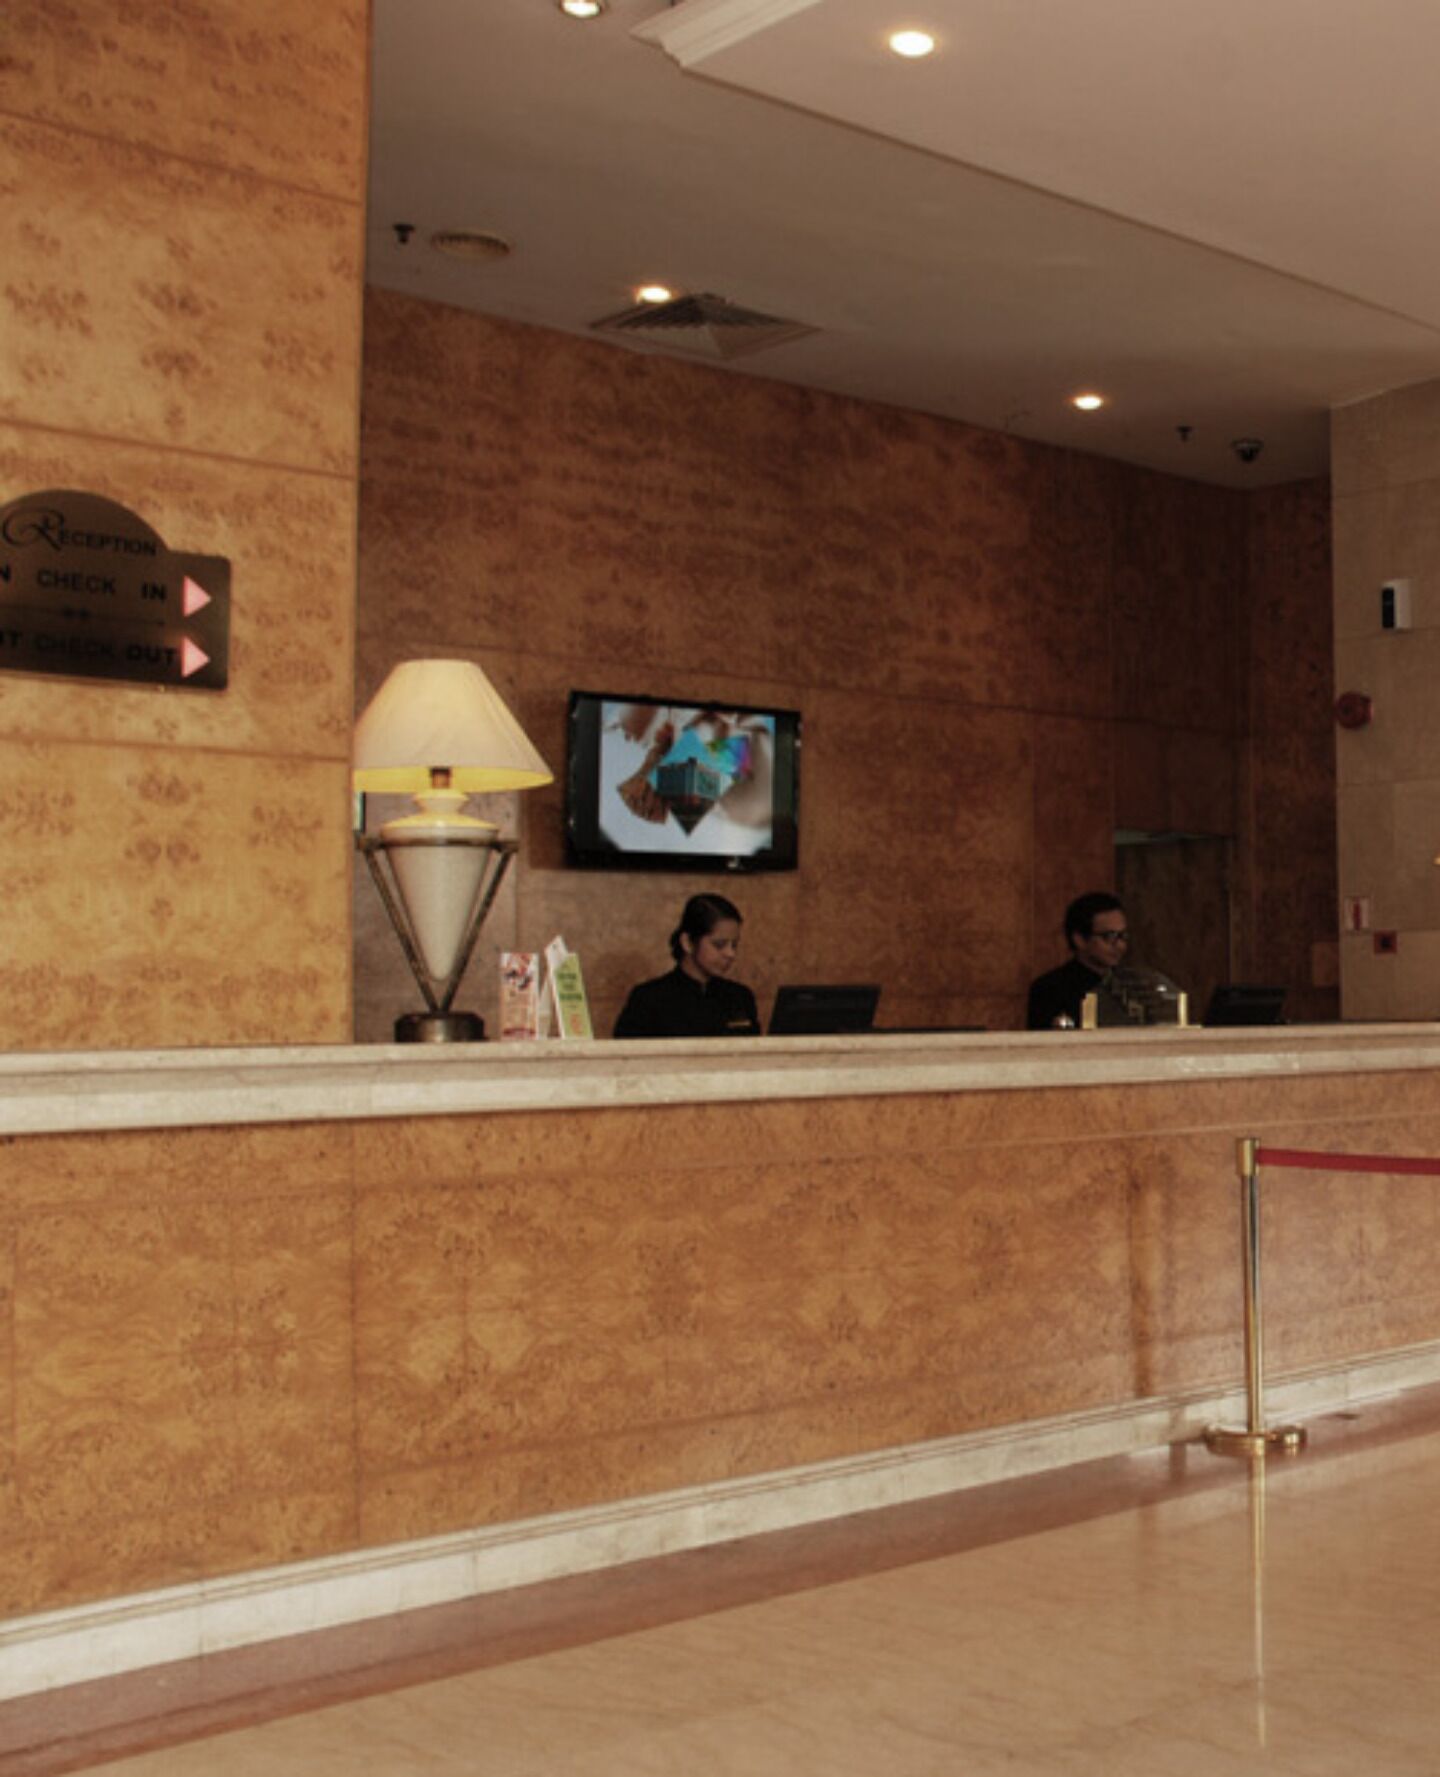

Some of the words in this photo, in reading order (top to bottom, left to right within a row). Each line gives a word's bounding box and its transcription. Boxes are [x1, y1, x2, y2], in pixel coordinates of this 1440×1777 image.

[37, 569, 116, 596] CHECK
[141, 582, 166, 603] IN
[35, 634, 115, 659] CHECK
[126, 644, 176, 665] OUT
